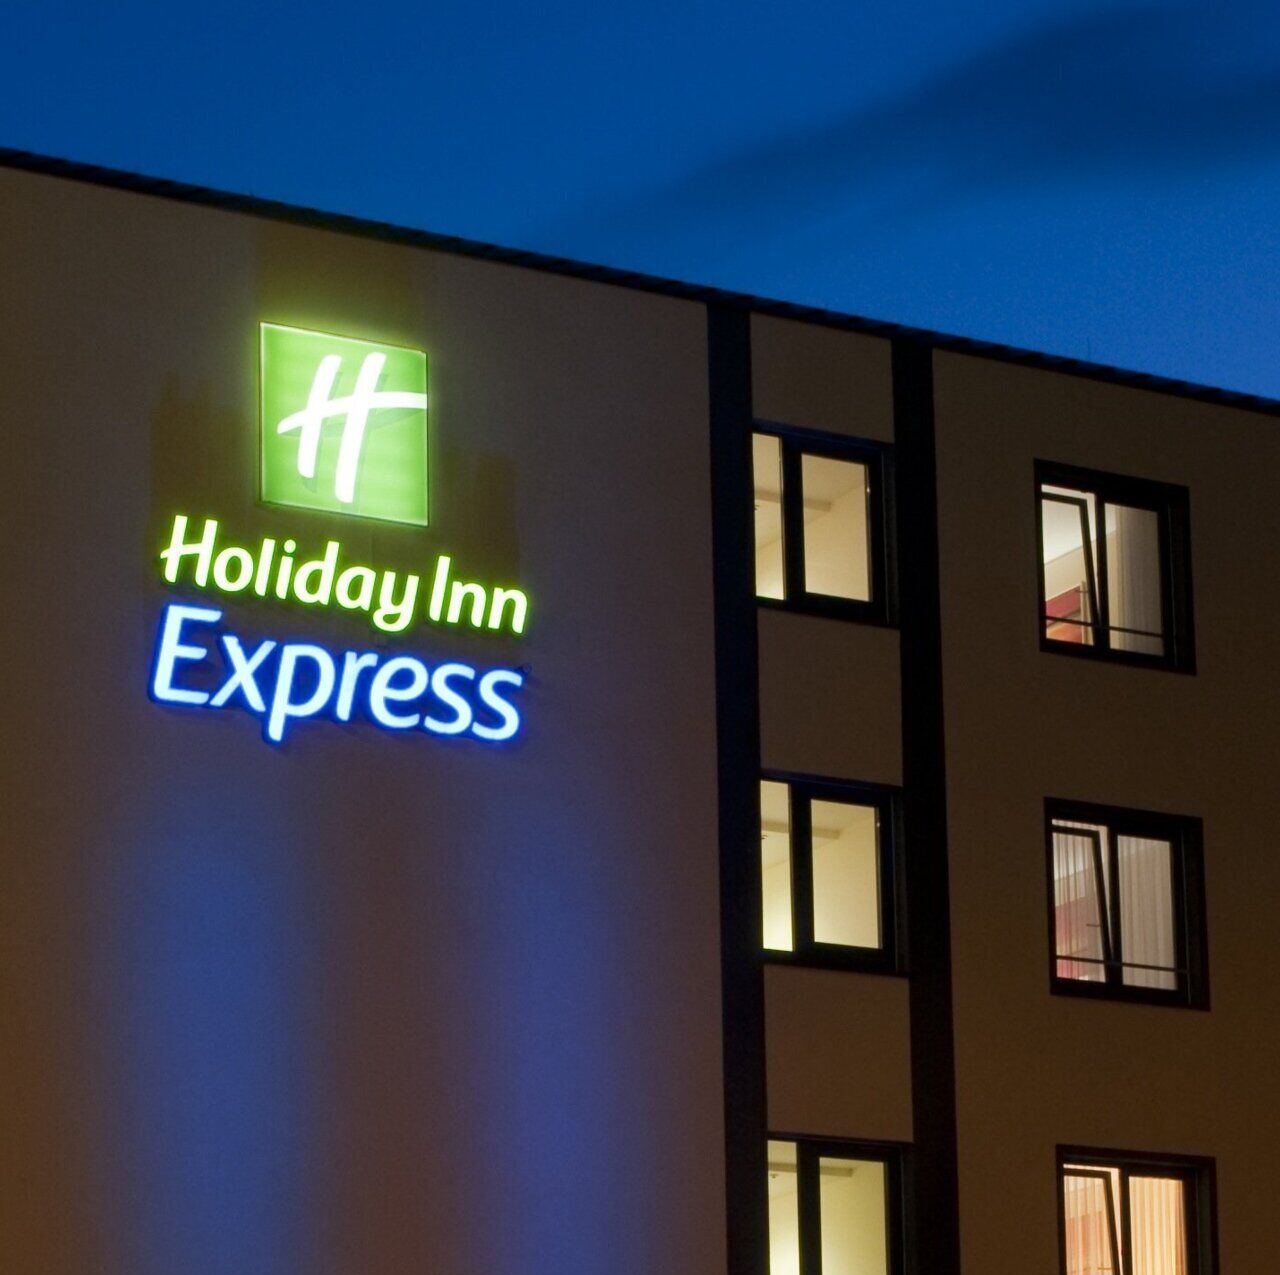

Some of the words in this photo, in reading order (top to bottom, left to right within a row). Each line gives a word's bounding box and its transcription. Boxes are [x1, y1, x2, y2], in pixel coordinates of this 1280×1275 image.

[276, 352, 428, 503] H
[160, 515, 420, 632] Holiday
[429, 556, 528, 634] Inn
[153, 604, 524, 742] Express
